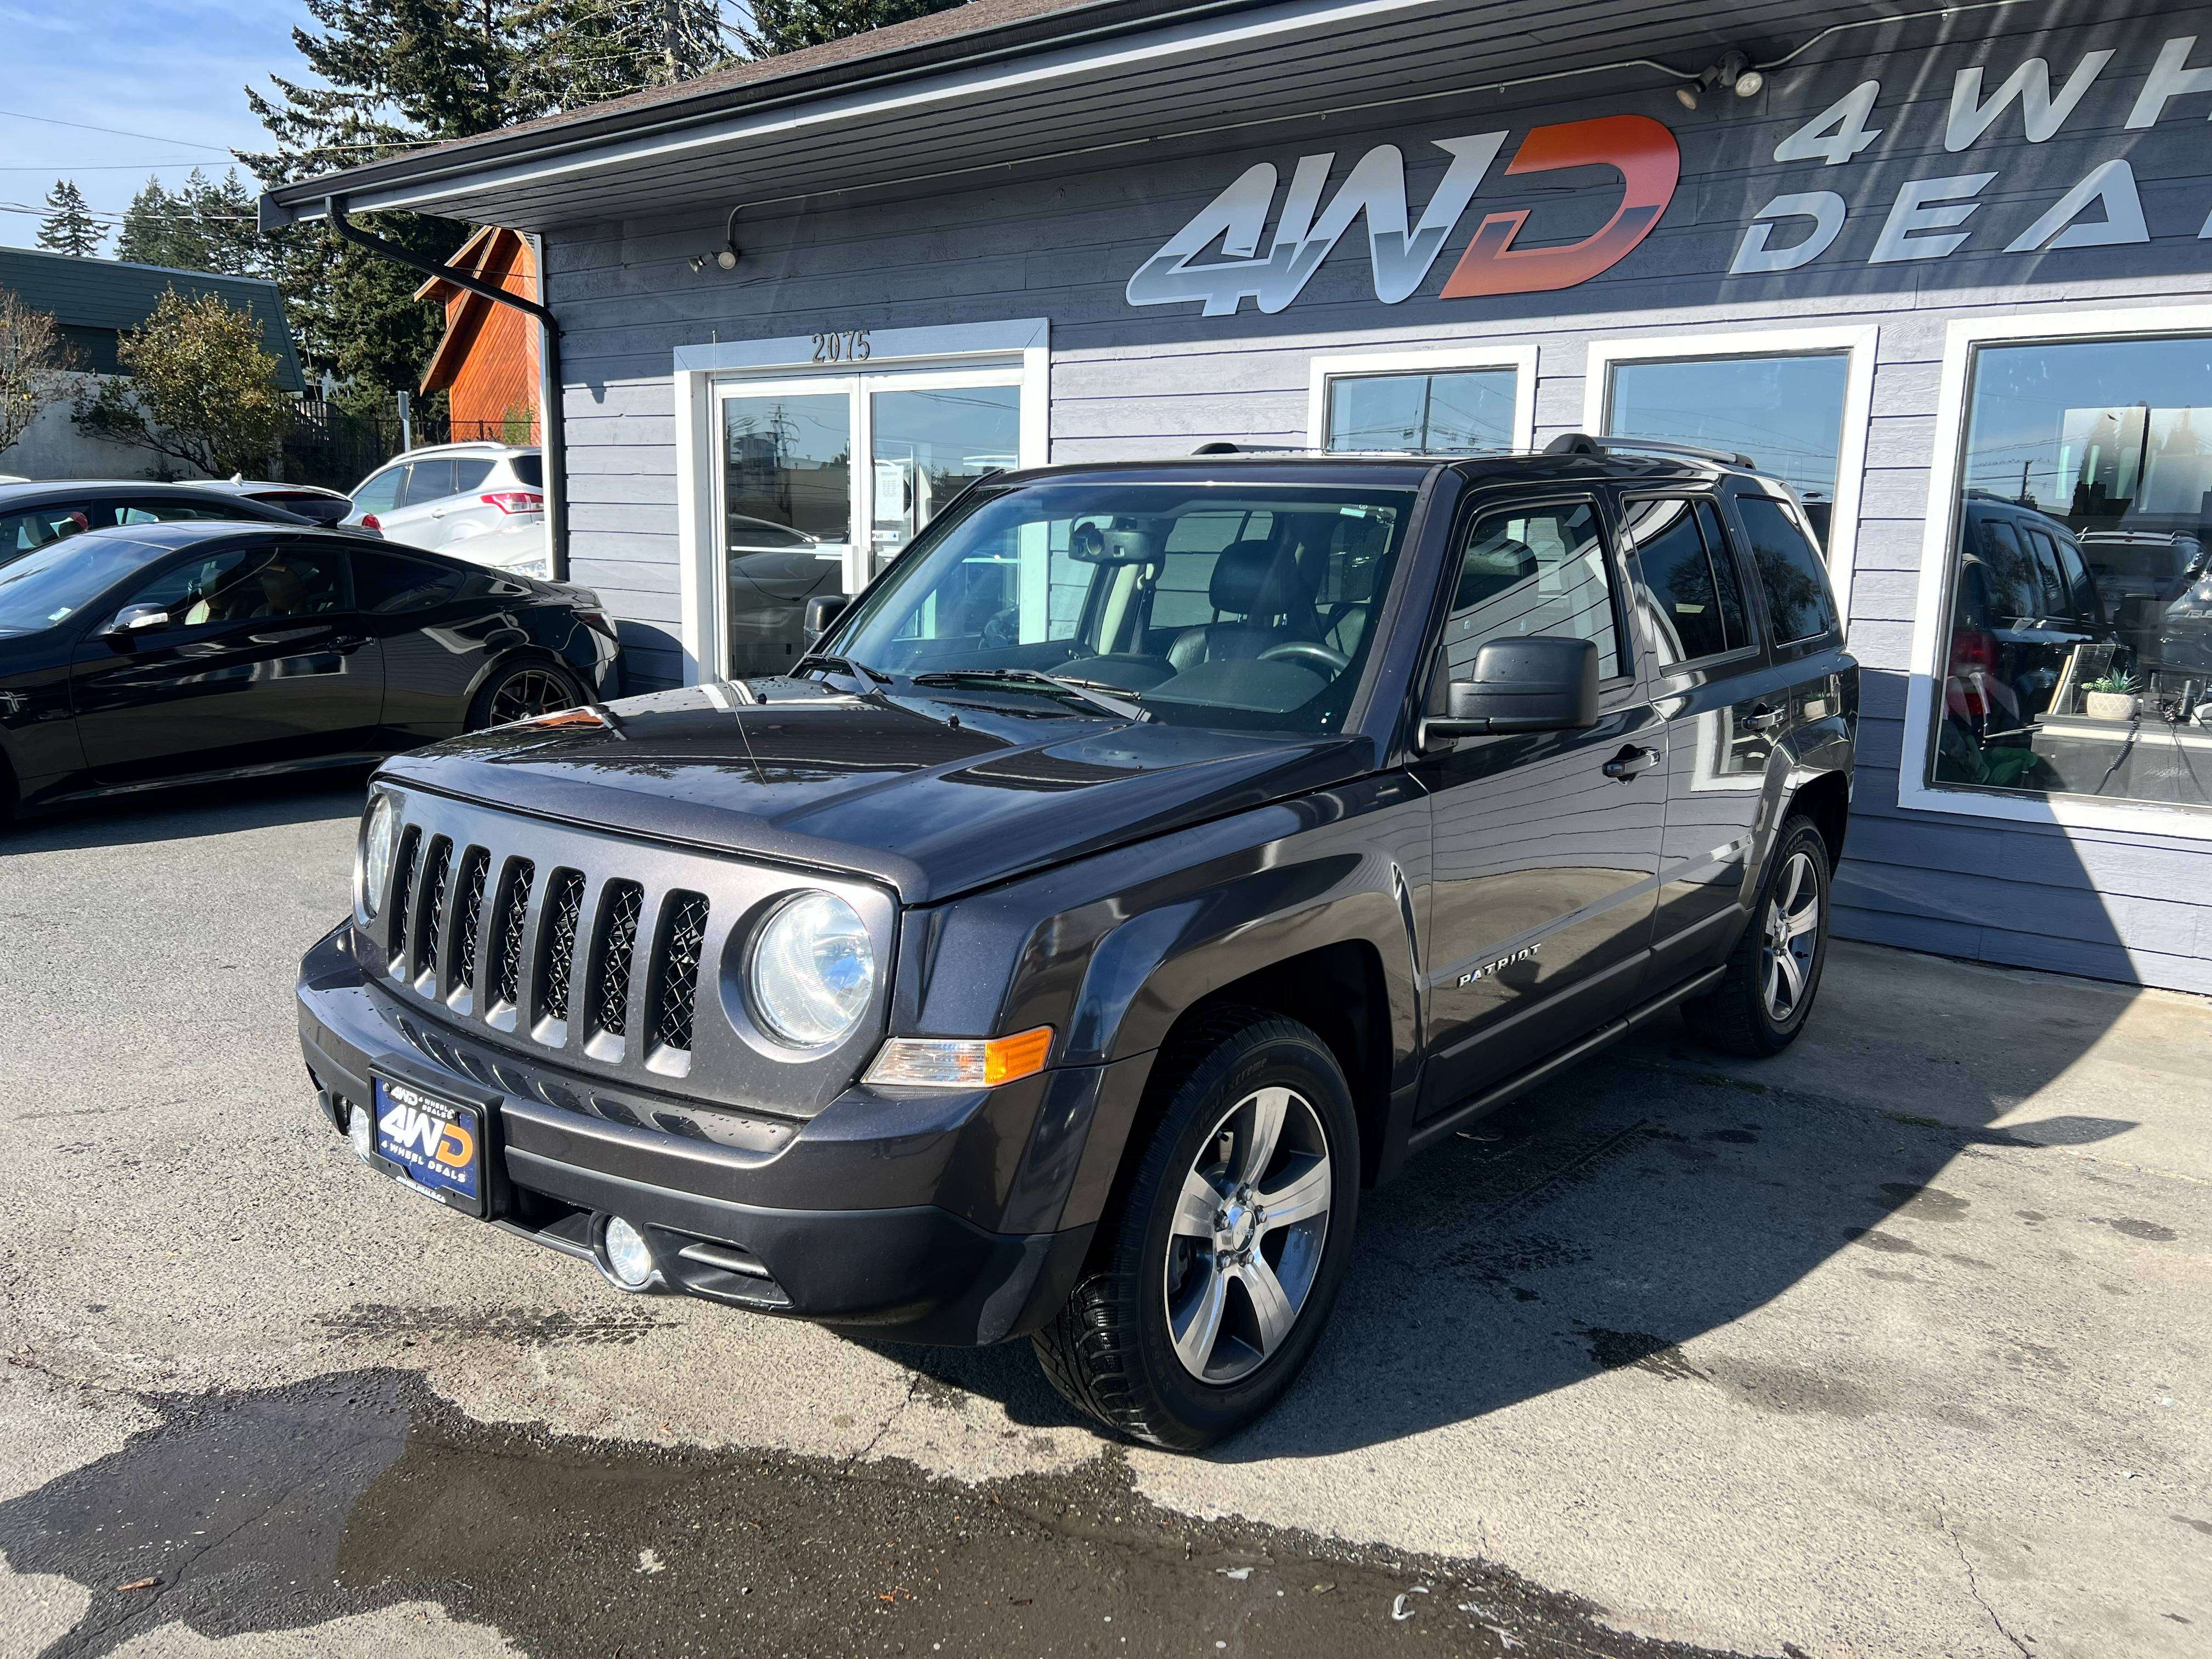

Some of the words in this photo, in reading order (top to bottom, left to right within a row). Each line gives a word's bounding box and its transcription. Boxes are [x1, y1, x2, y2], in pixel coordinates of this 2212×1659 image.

[1773, 80, 1883, 165] 4
[1126, 115, 1680, 317] 4WD
[1729, 159, 2212, 274] DEA
[812, 329, 870, 363] 2075
[1457, 943, 1541, 988] PATRIOT
[391, 1086, 417, 1106] 4WD
[421, 1104, 446, 1118] DEALS
[425, 1098, 449, 1113] WHEEL
[380, 1104, 473, 1167] 4WD
[381, 1140, 387, 1148] 4
[390, 1143, 424, 1165] WHEEL
[427, 1160, 466, 1183] DEALS
